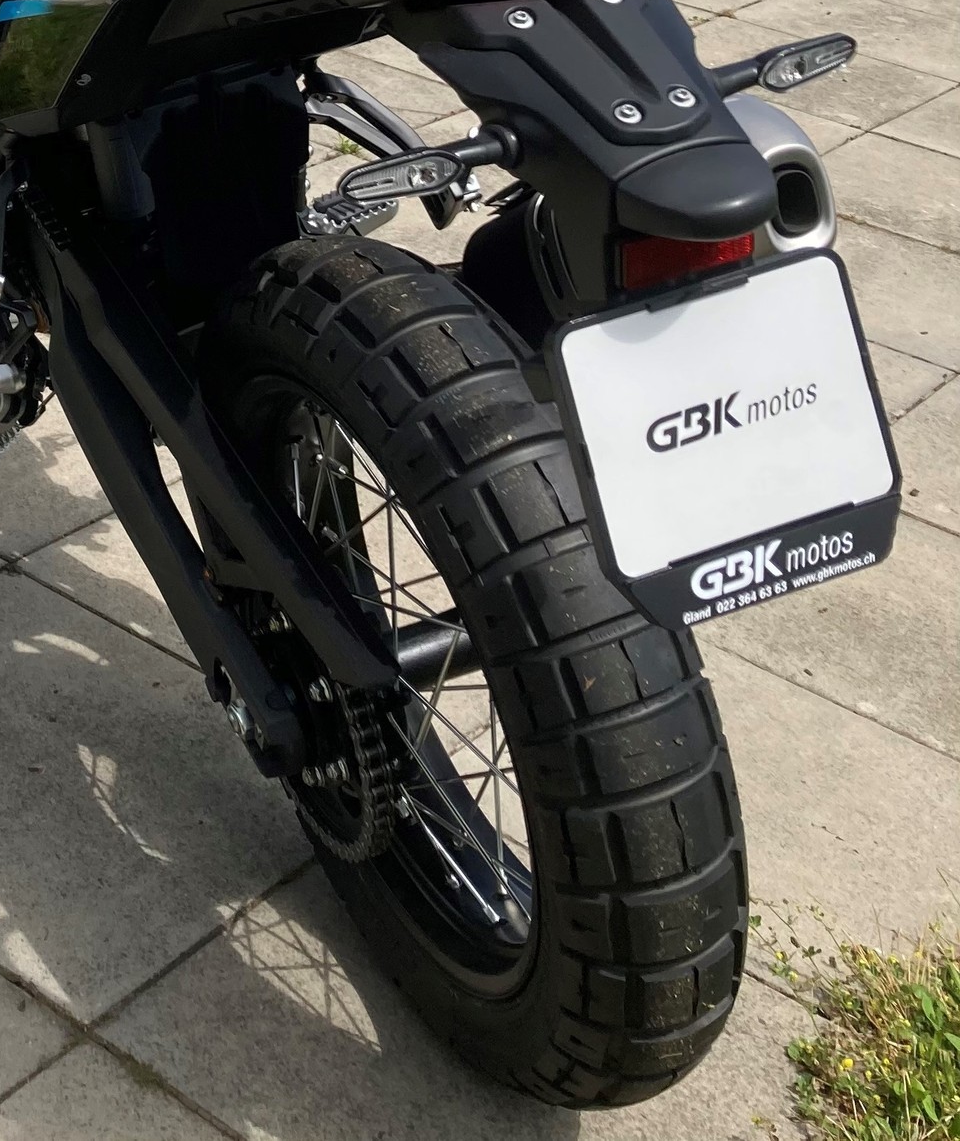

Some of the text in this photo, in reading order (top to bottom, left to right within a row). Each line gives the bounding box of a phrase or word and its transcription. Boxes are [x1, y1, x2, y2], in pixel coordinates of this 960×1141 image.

[646, 382, 817, 453] GBK motos
[682, 551, 876, 625] Gland 022 364 63 63 www.gbkmotos.ch
[690, 531, 854, 600] GBK motos
